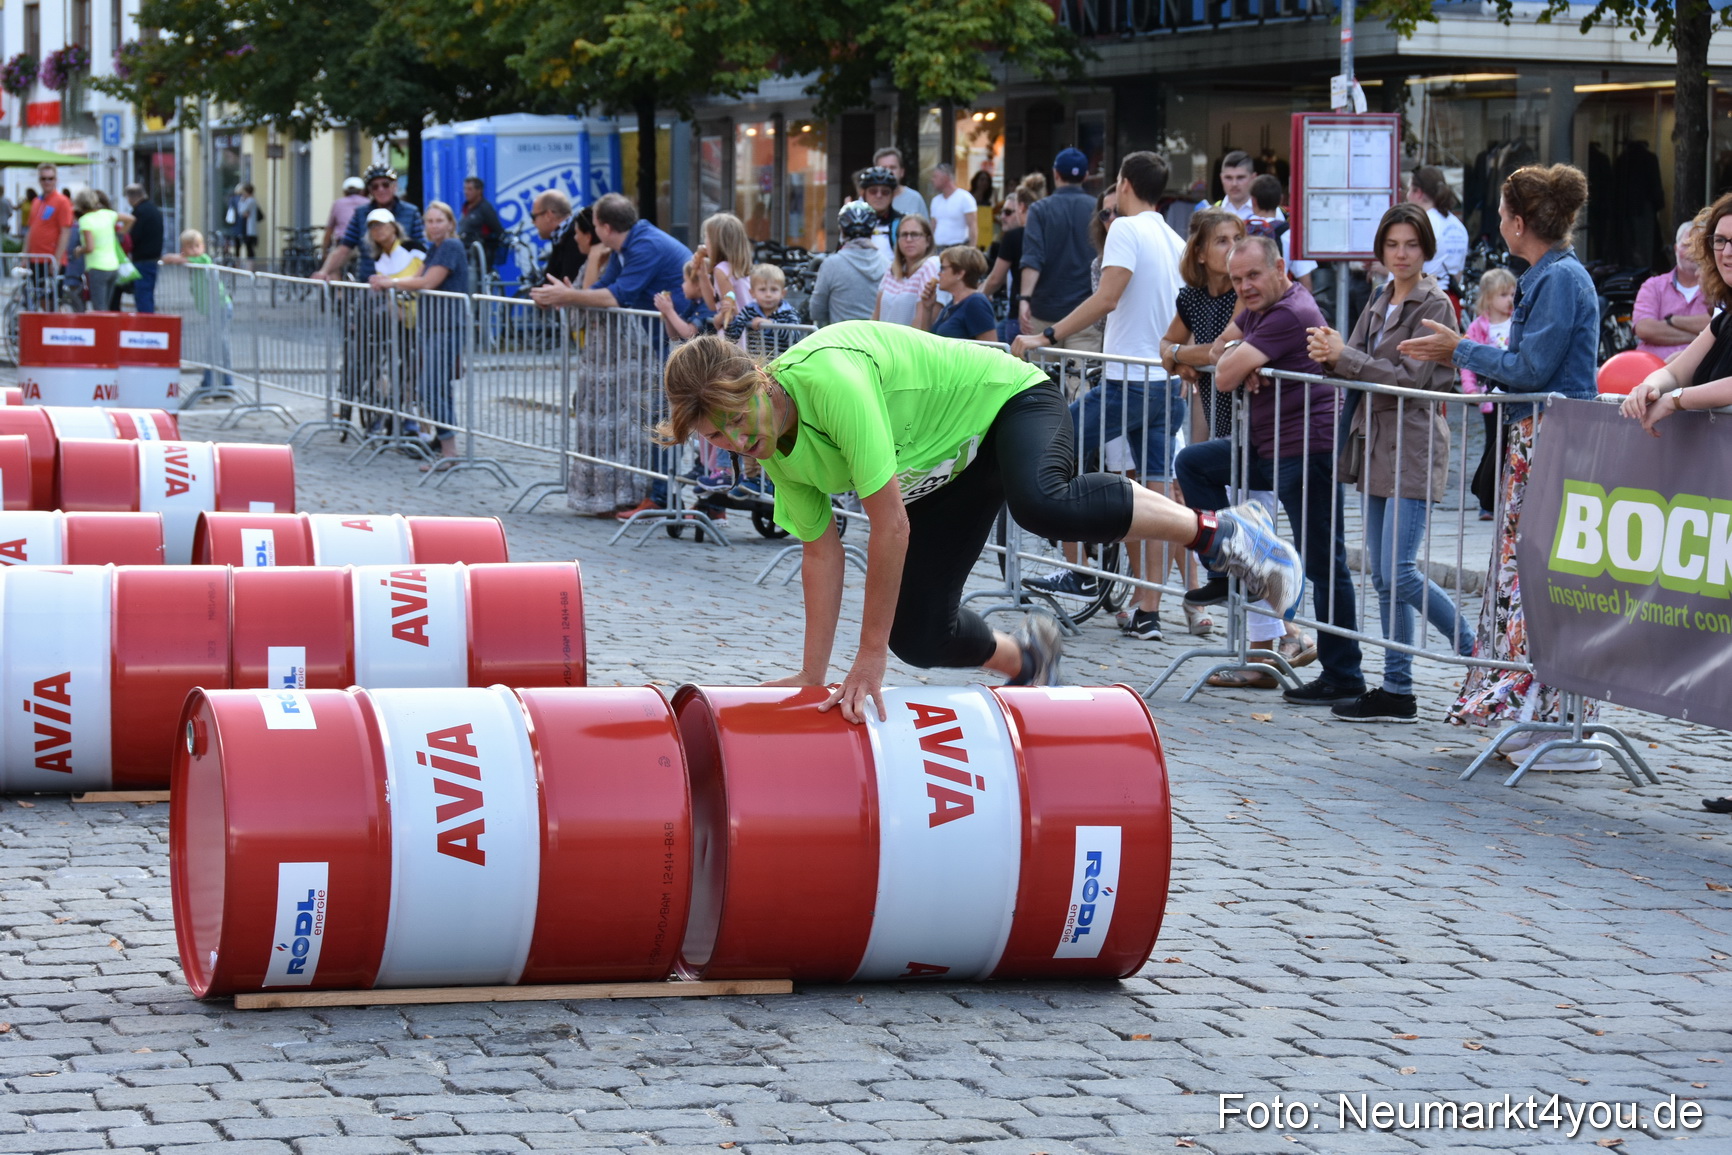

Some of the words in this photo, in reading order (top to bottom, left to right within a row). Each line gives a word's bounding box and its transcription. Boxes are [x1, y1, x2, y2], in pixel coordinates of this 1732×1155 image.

[1548, 577, 1620, 614] inspired
[1624, 590, 1640, 624] by
[1640, 602, 1690, 629] smart
[663, 822, 675, 885] 12414-B&B
